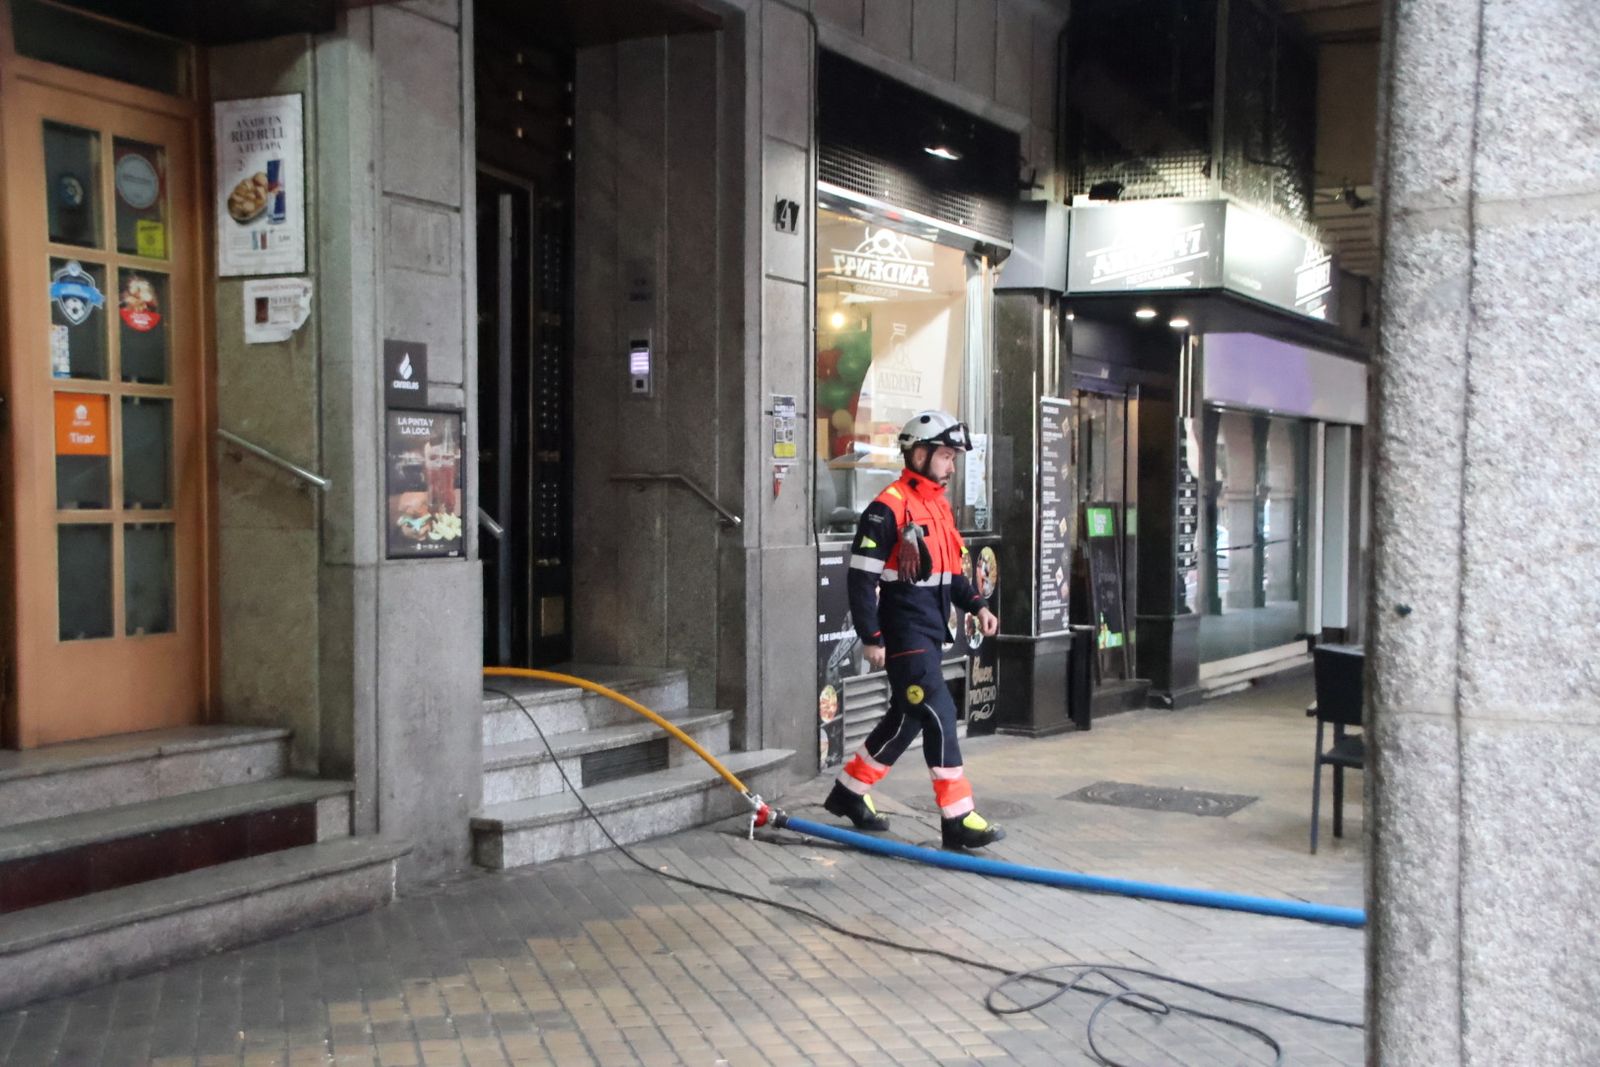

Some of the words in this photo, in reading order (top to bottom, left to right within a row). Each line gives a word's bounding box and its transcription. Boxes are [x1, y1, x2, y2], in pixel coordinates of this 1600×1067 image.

[231, 129, 255, 142] RED
[257, 127, 285, 140] BULL
[1092, 229, 1202, 278] AN47
[397, 418, 408, 426] LA
[408, 418, 428, 427] PINTA
[429, 419, 434, 428] Y
[401, 426, 411, 435] LA
[412, 427, 431, 436] LOCA
